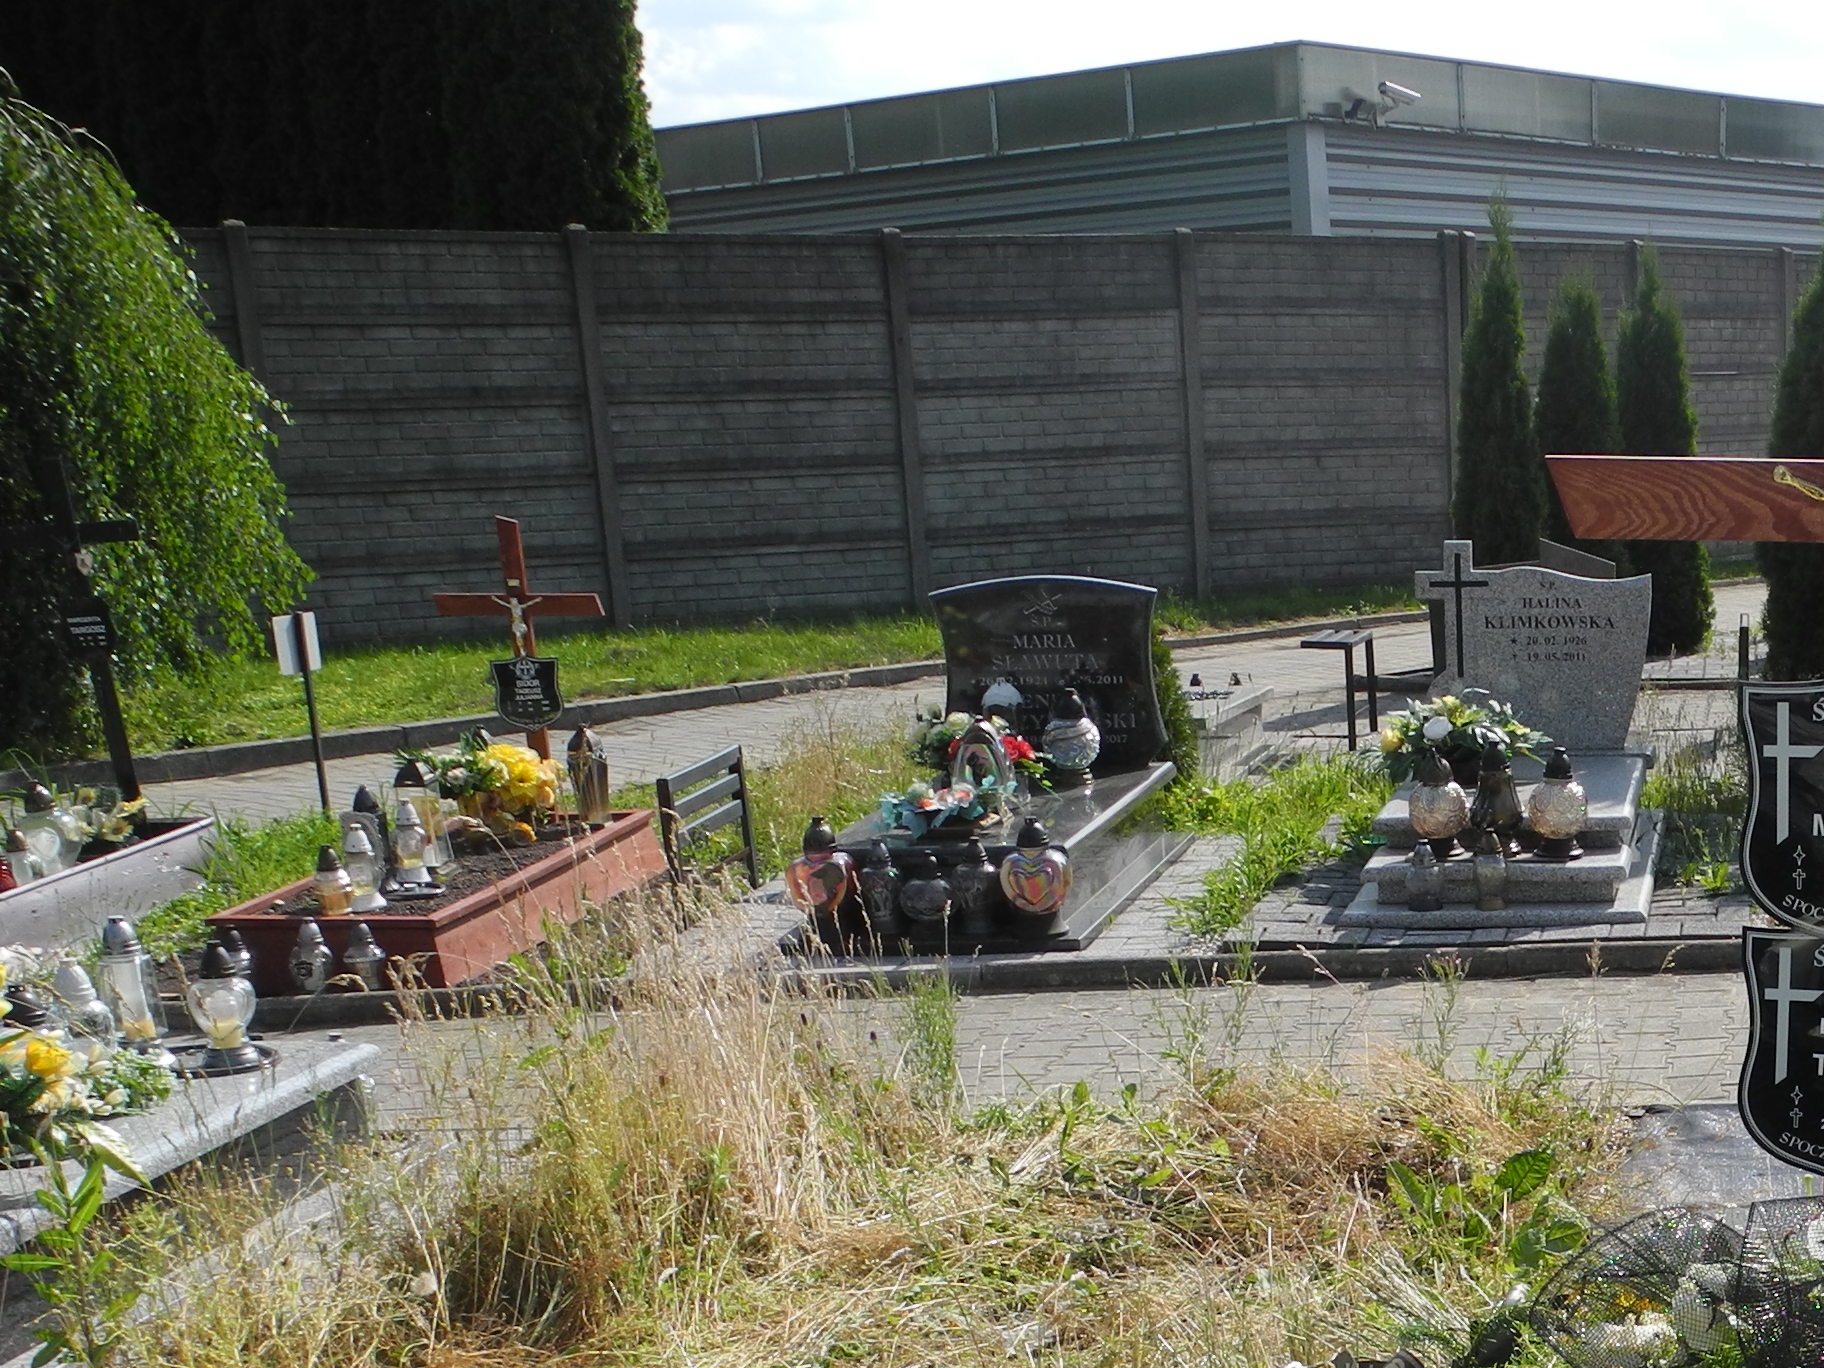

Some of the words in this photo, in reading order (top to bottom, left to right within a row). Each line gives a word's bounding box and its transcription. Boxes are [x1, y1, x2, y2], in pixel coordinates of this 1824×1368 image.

[1522, 597, 1582, 609] HALINA
[1484, 615, 1616, 630] KLIMKOWSKA
[1013, 634, 1076, 649] MARIA
[991, 653, 1099, 671] SŁAWUTA
